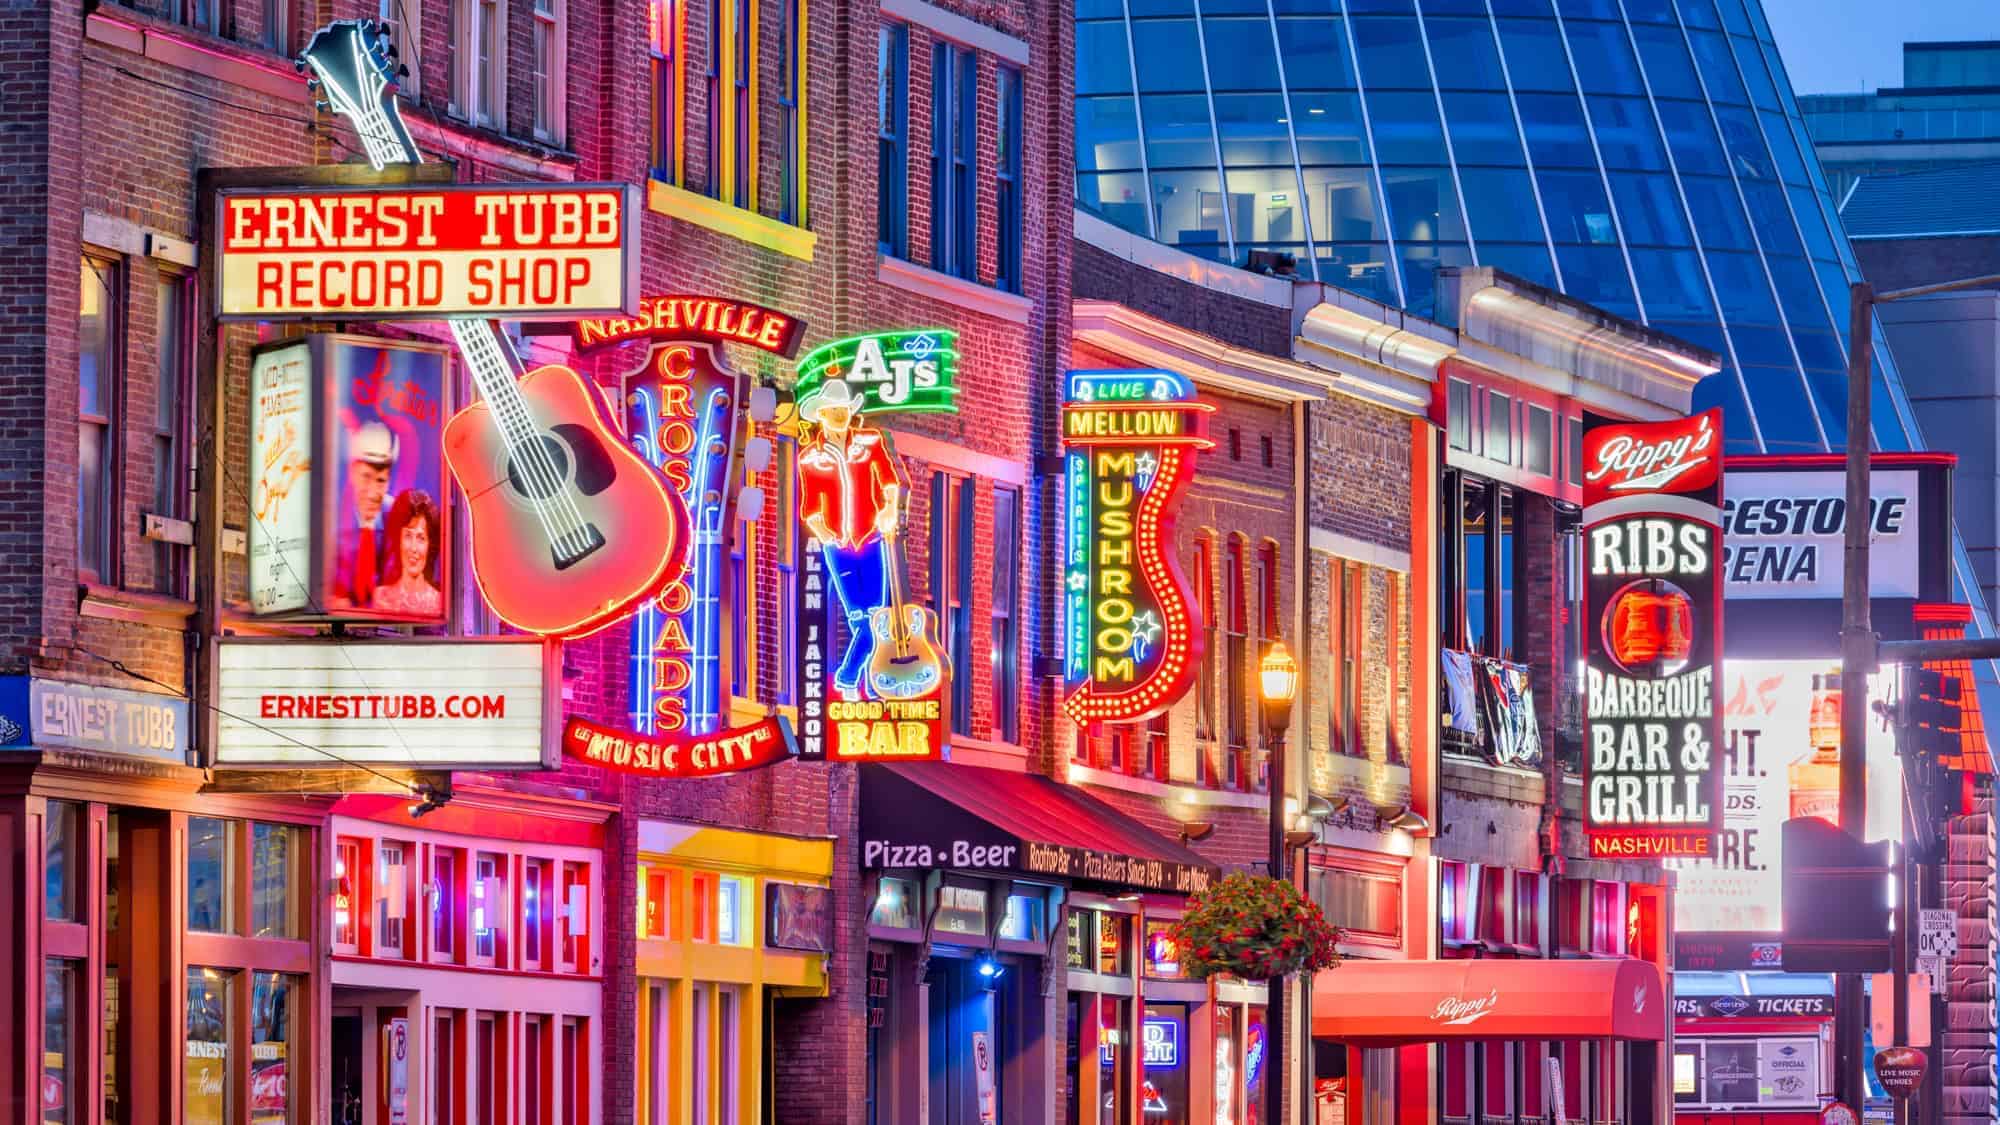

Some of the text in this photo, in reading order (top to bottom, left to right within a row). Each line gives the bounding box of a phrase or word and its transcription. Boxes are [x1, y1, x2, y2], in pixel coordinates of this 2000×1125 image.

[229, 193, 620, 248] ERNEST TUBB
[257, 257, 591, 308] RECORD SHOP
[579, 298, 788, 348] NASHVILLE
[1098, 382, 1145, 398] LIVE
[1069, 411, 1178, 435] MELLOW
[1586, 415, 1713, 480] Rippy's
[1723, 498, 1906, 535] ESTOE
[655, 345, 697, 732] CROSOADS
[1591, 519, 1707, 575] RIBS
[1097, 452, 1135, 682] MUSHROOM
[805, 537, 822, 754] ALAN JACKSON
[260, 695, 505, 719] ERNESTTUBB.COM
[1587, 664, 1713, 718] BARBEQUE
[41, 692, 175, 751] ERNEST TUBB
[829, 699, 941, 720] GOOD TIME
[837, 721, 931, 756] BAR
[1591, 722, 1710, 771] BAR &
[1590, 775, 1710, 824] GRILL
[864, 840, 1016, 868] Pizza Beer
[1029, 843, 1071, 874] Rooftop Bar
[1594, 837, 1708, 854] NASHVILLE
[1084, 851, 1101, 878] Pizza
[1127, 859, 1145, 885] Since
[1176, 864, 1209, 892] Live Music
[1923, 911, 1952, 921] DIAGONAL
[1924, 921, 1952, 930] CROSSING
[1920, 934, 1935, 950] OK
[1430, 987, 1497, 1019] Rippy's
[1757, 999, 1823, 1013] TICKETS
[1771, 1060, 1806, 1068] OFFICIAL
